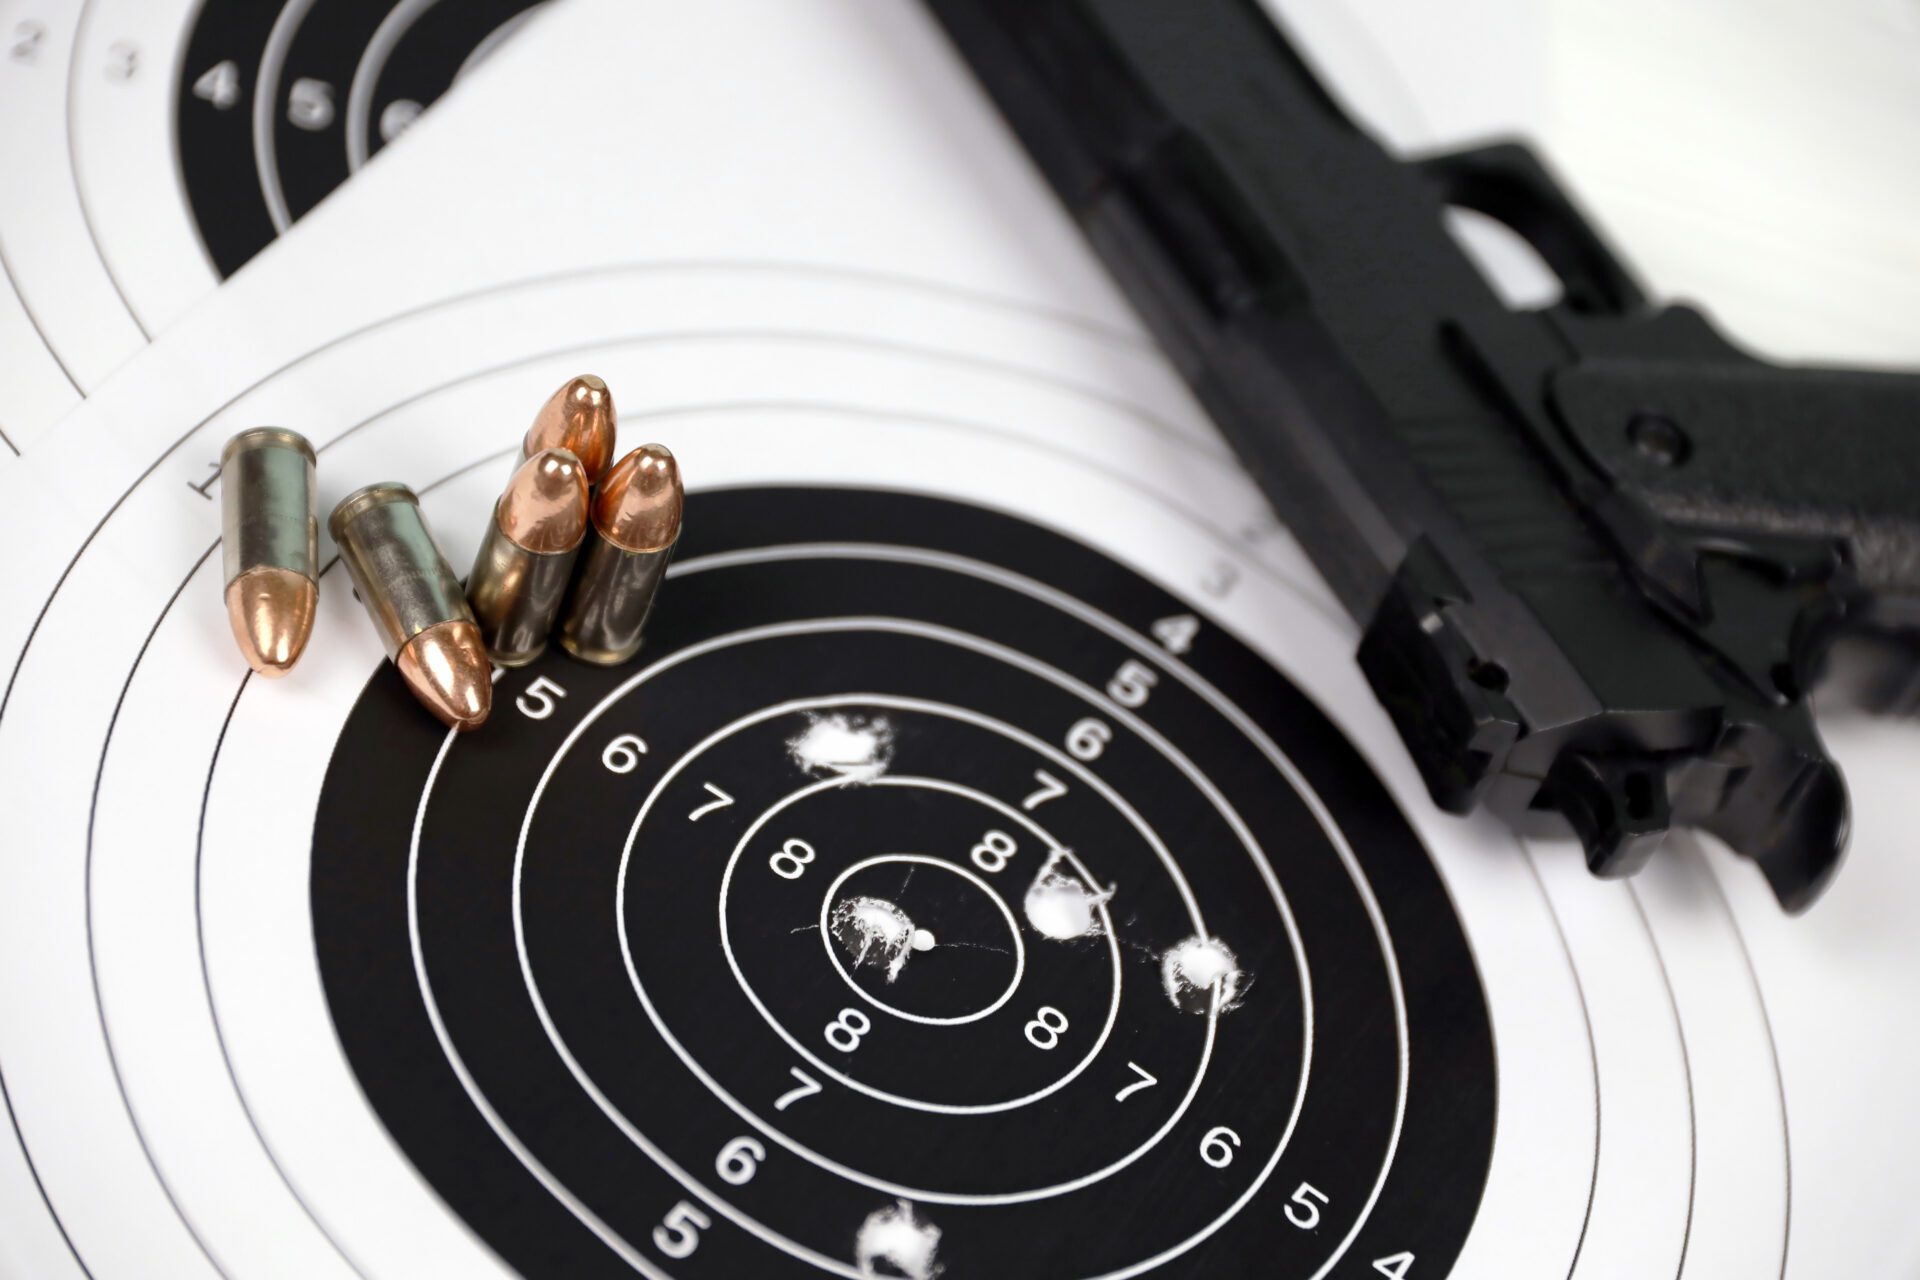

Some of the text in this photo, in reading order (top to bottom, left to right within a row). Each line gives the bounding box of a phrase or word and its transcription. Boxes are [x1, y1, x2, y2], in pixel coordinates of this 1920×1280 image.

[192, 59, 241, 110] 4
[287, 77, 335, 131] 5
[1150, 615, 1199, 656] 4
[515, 675, 567, 720] 5
[1106, 659, 1158, 708] 5
[601, 733, 649, 774] 6
[1065, 717, 1112, 761] 6
[688, 781, 735, 822] 7
[1022, 769, 1068, 811] 7
[768, 837, 816, 880] 8
[970, 829, 1018, 873] 8
[823, 1007, 872, 1053] 8
[1023, 1005, 1069, 1051] 8
[773, 1066, 823, 1111] 7
[1114, 1061, 1158, 1103] 7
[715, 1135, 766, 1186] 6
[1199, 1125, 1242, 1169] 6
[1283, 1181, 1330, 1230] 5
[652, 1201, 711, 1259] 5
